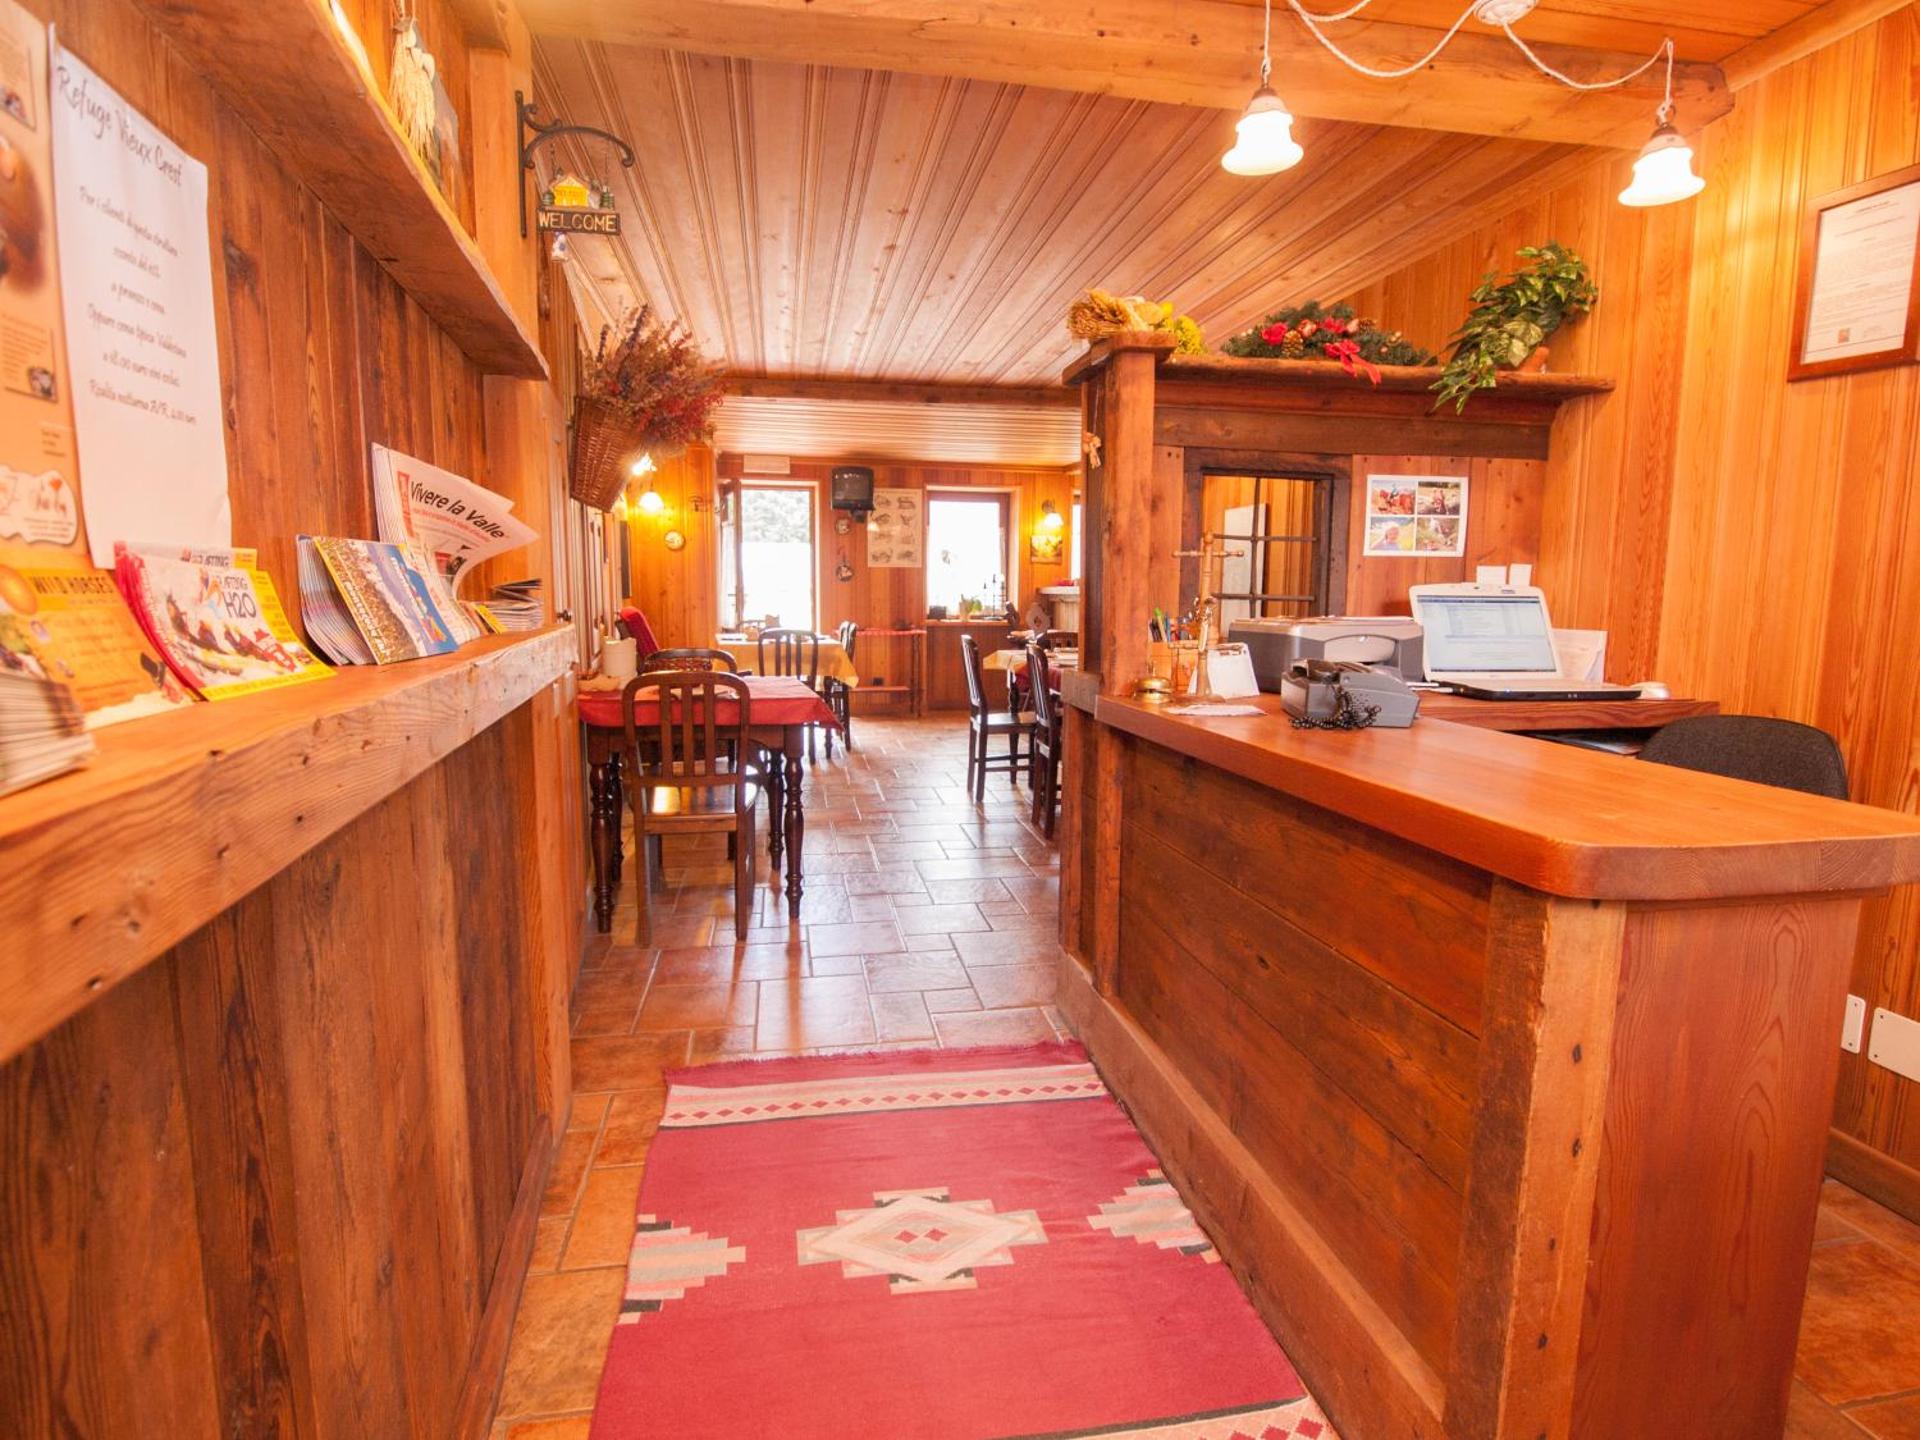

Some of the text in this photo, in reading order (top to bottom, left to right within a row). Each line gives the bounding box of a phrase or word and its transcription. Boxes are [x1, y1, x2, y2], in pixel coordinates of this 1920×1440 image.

[56, 65, 111, 139] Refuge
[538, 212, 617, 233] WELCOME
[410, 480, 449, 509] Vivere
[446, 499, 466, 516] la
[465, 509, 505, 539] Valle
[223, 591, 257, 619] H2O
